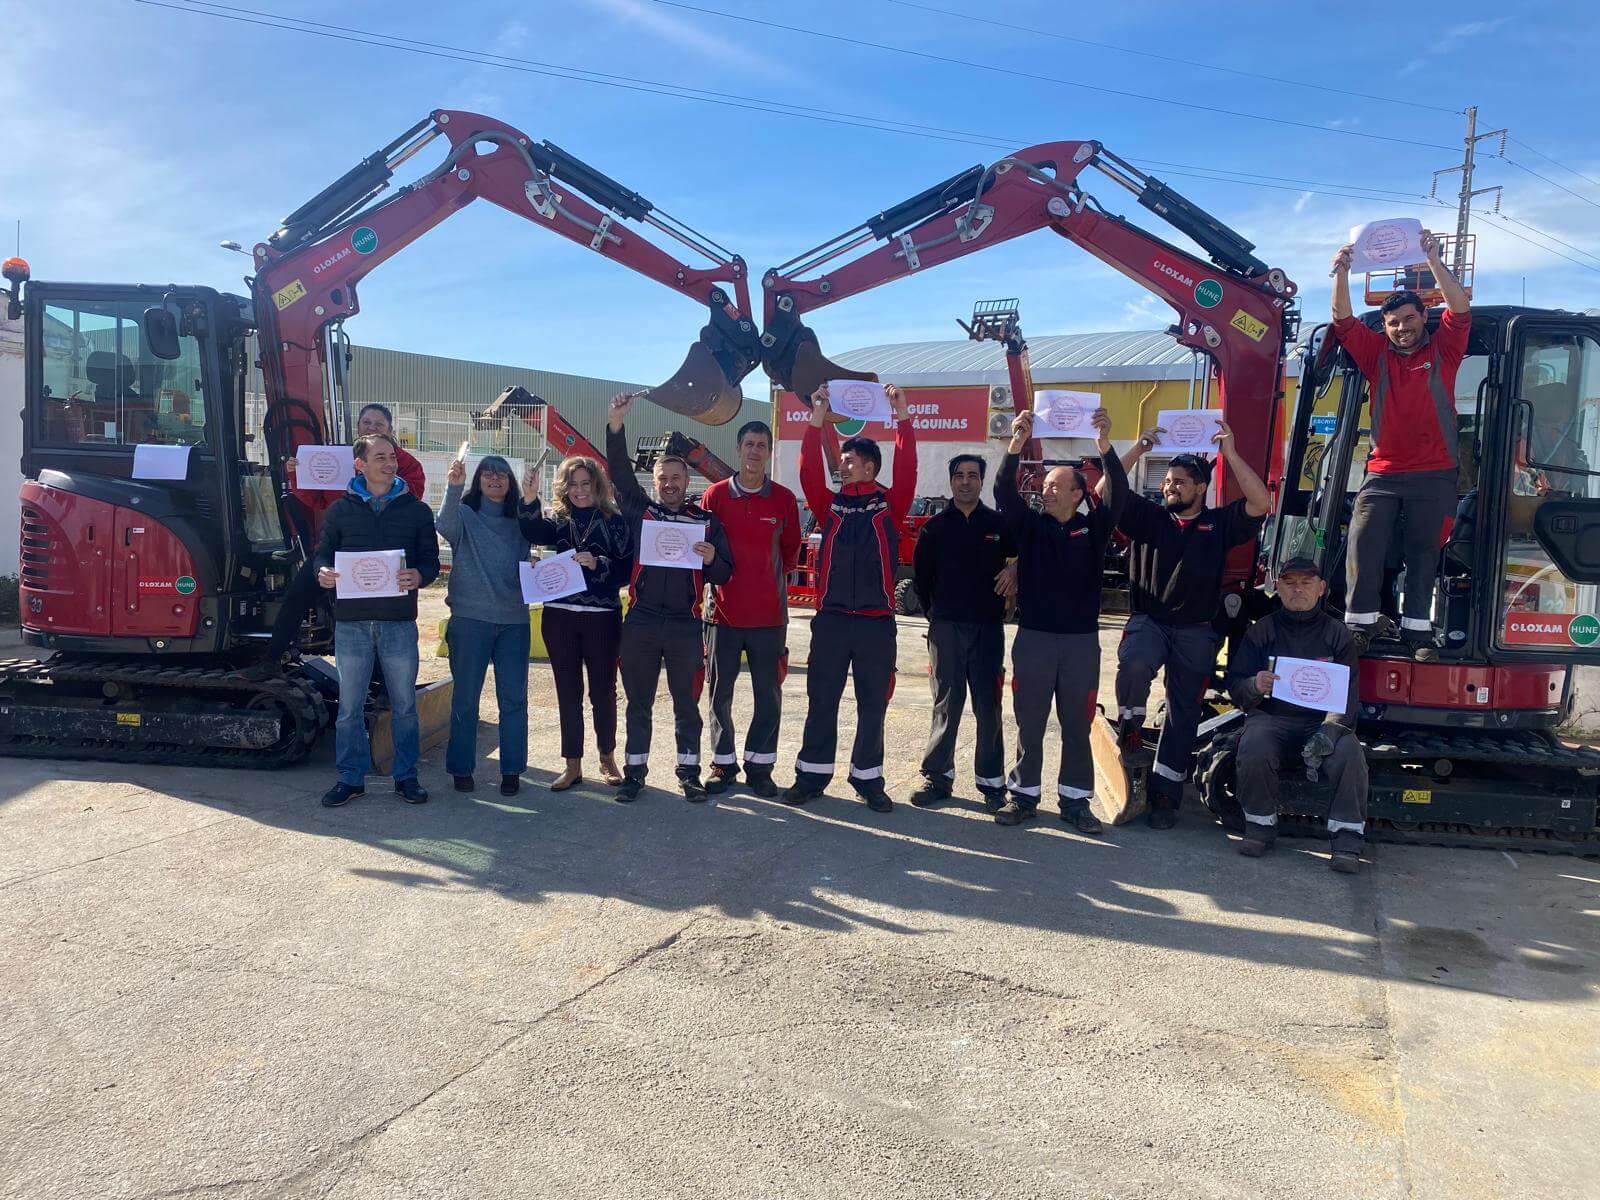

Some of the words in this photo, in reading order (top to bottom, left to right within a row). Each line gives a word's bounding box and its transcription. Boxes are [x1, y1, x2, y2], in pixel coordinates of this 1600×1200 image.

[320, 247, 352, 270] LOXAM
[354, 232, 375, 249] HUNE
[1160, 264, 1193, 287] LOXAM
[1197, 285, 1220, 302] HUNE
[893, 404, 939, 415] GUER
[786, 411, 813, 422] LOX
[911, 416, 968, 429] ÁQUINAS
[1520, 623, 1563, 633] LOXAM
[1571, 626, 1599, 634] HUNE
